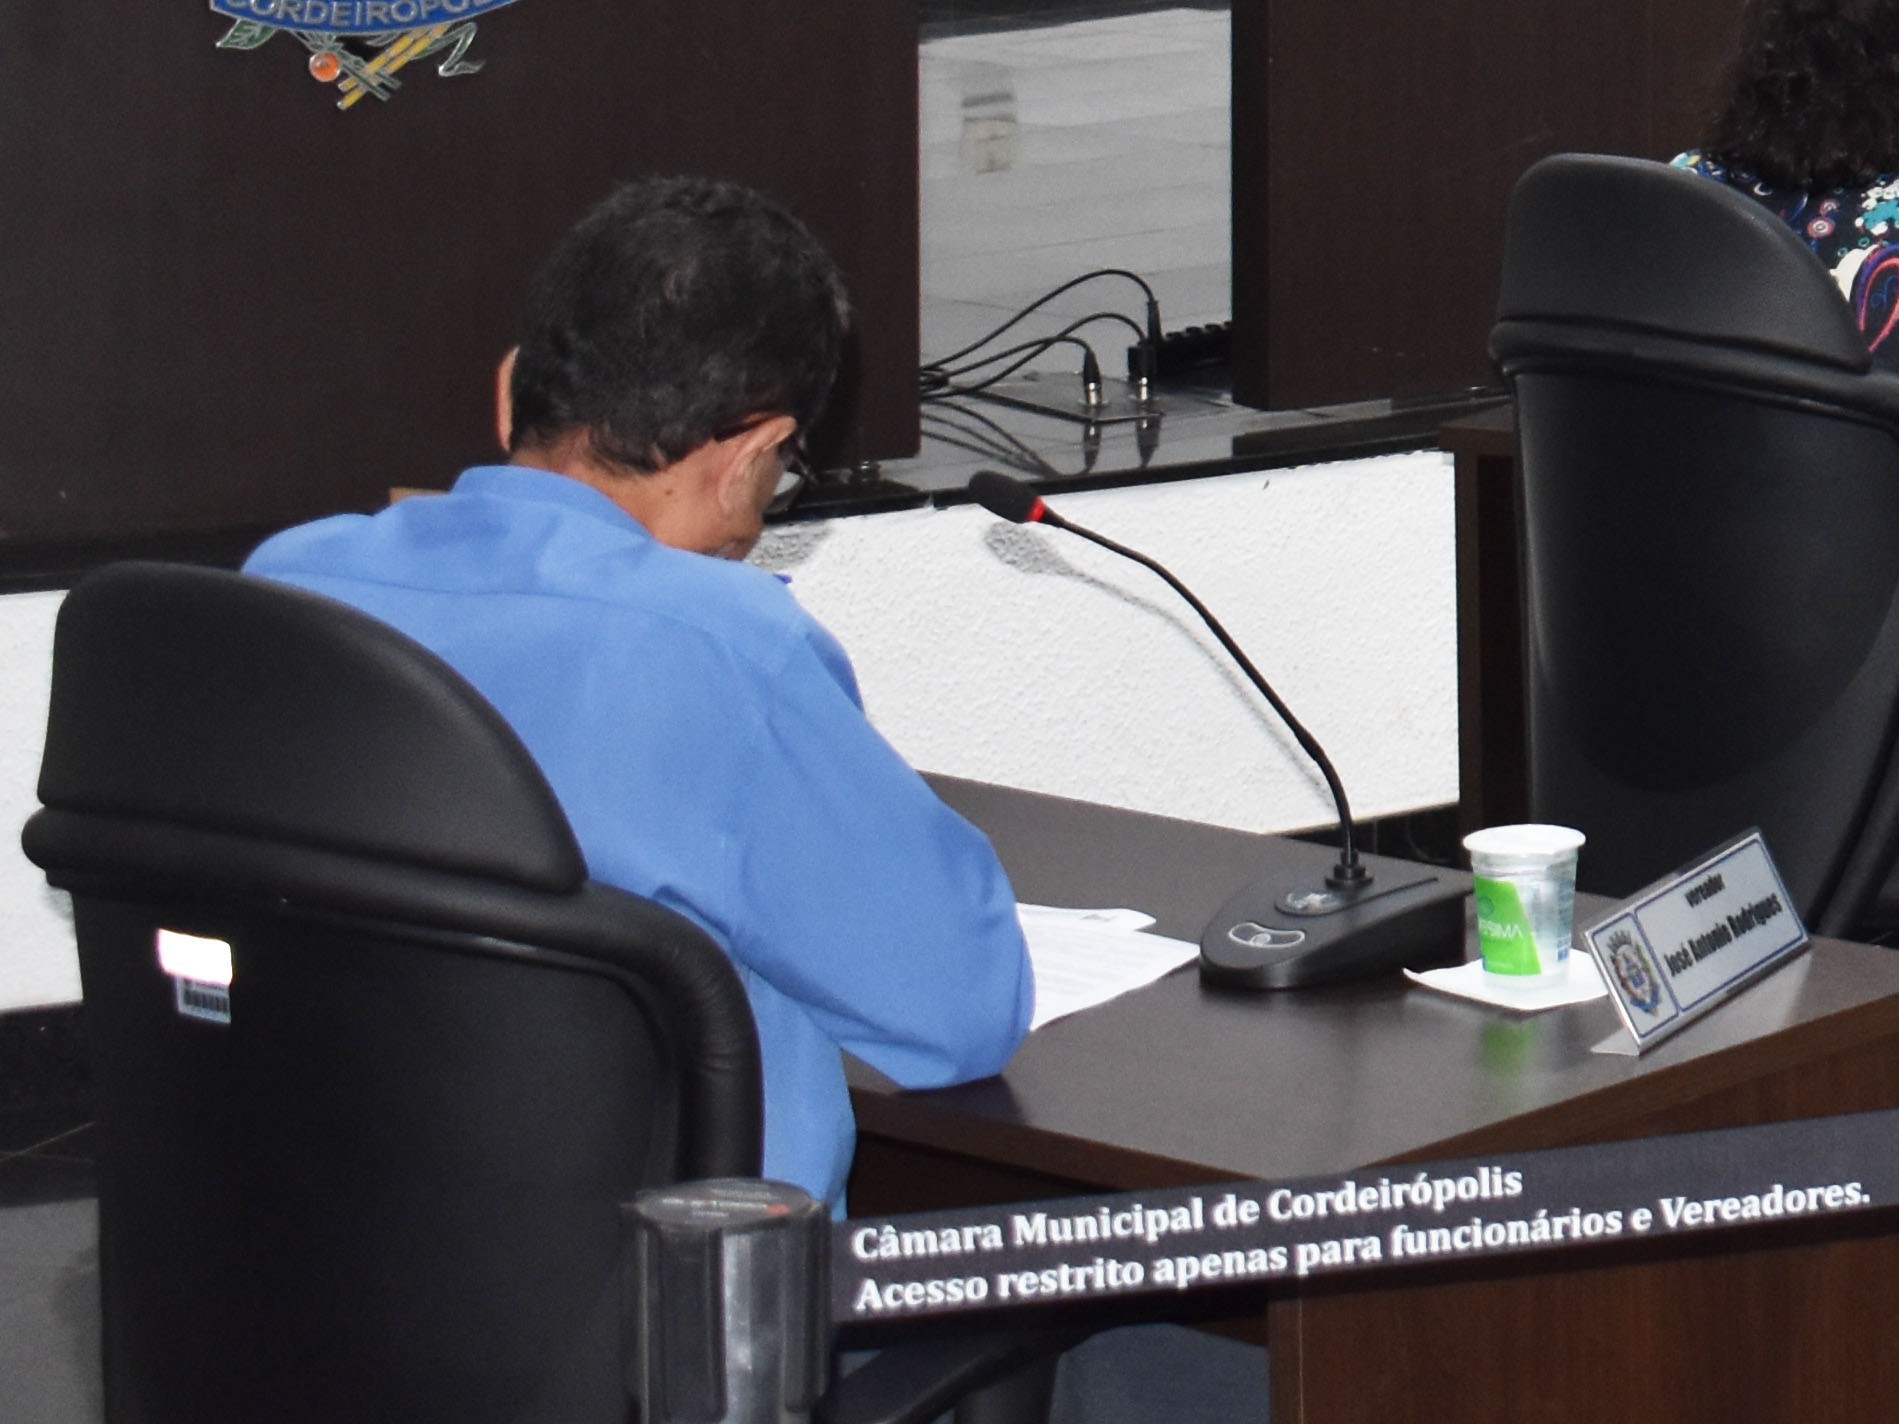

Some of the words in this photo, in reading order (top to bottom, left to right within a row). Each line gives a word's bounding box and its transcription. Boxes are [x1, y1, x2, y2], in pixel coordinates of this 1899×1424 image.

[1727, 892, 1783, 939] Rodrigues
[852, 1220, 1003, 1262] Câmara
[1013, 1192, 1205, 1247] Municipal
[1216, 1194, 1260, 1227] de
[1268, 1166, 1524, 1221] Cordeirópolis
[854, 1276, 988, 1312] Acesso
[999, 1254, 1145, 1299] restrito
[1153, 1244, 1289, 1289] apenas
[1297, 1234, 1381, 1275] para
[1391, 1208, 1624, 1259] funcionários
[1631, 1209, 1653, 1232] e
[1660, 1180, 1871, 1229] Vereadores.
